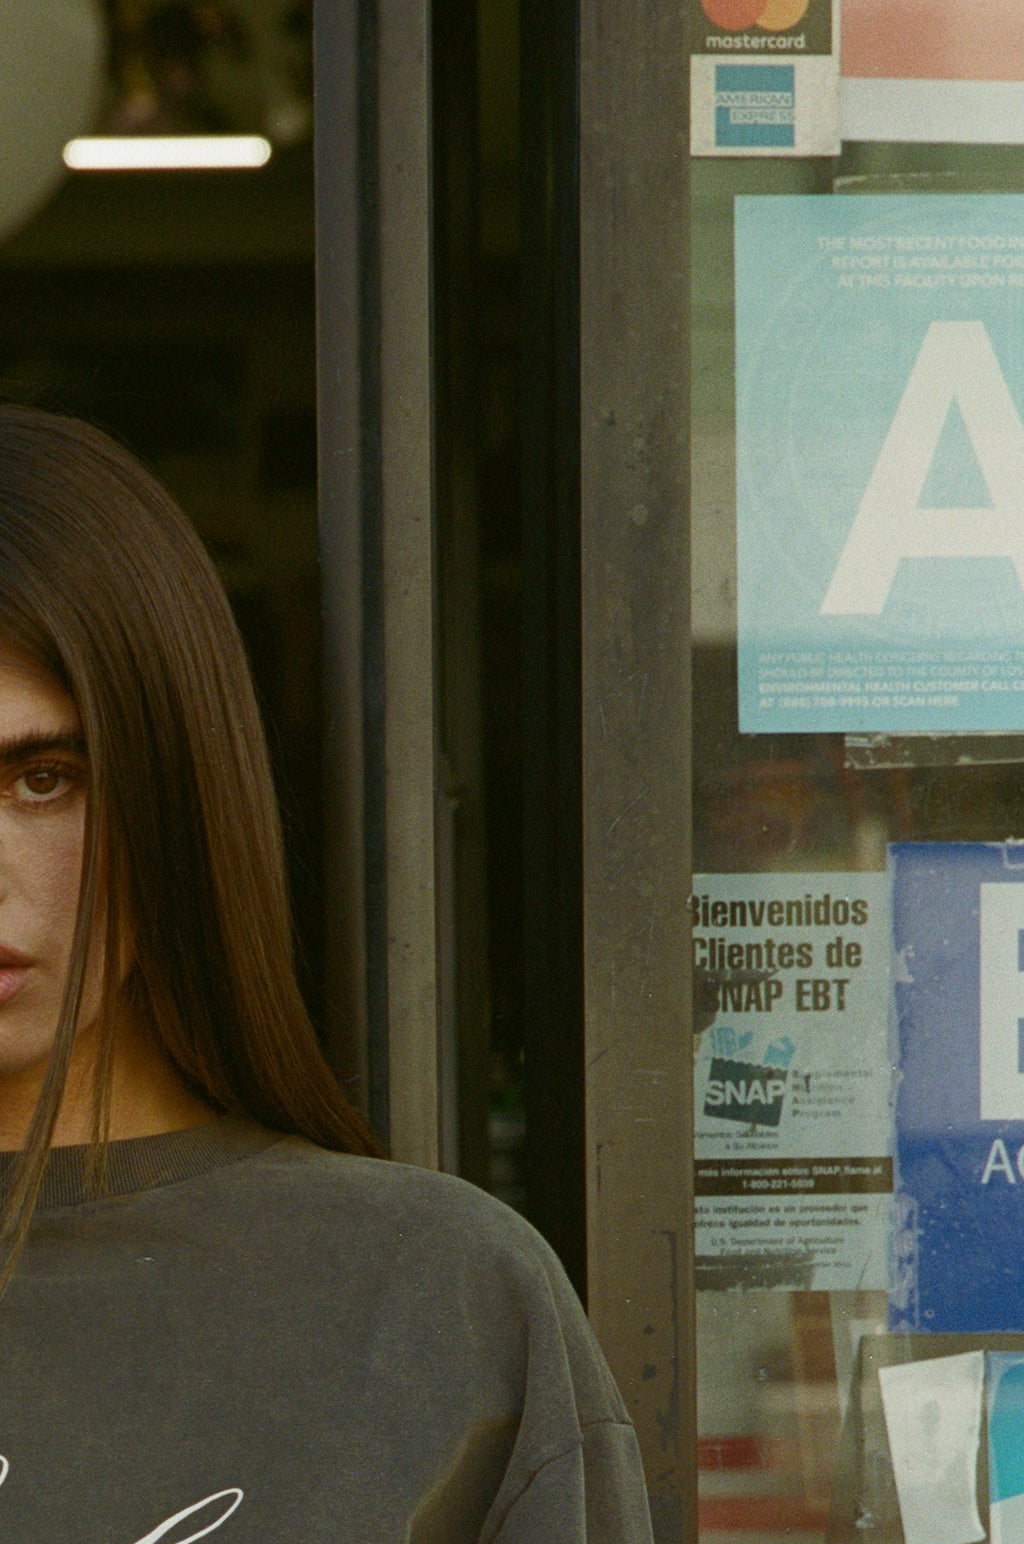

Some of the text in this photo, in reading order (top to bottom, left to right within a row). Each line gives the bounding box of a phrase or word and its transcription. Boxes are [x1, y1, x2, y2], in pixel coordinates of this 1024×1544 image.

[706, 34, 806, 49] mastercard
[818, 236, 844, 250] THE
[832, 255, 890, 269] REPORT
[819, 320, 1024, 615] A
[826, 936, 862, 969] de
[713, 977, 850, 1013] NAP EBT
[704, 1078, 786, 1106] SNAP
[981, 1138, 1024, 1184] A
